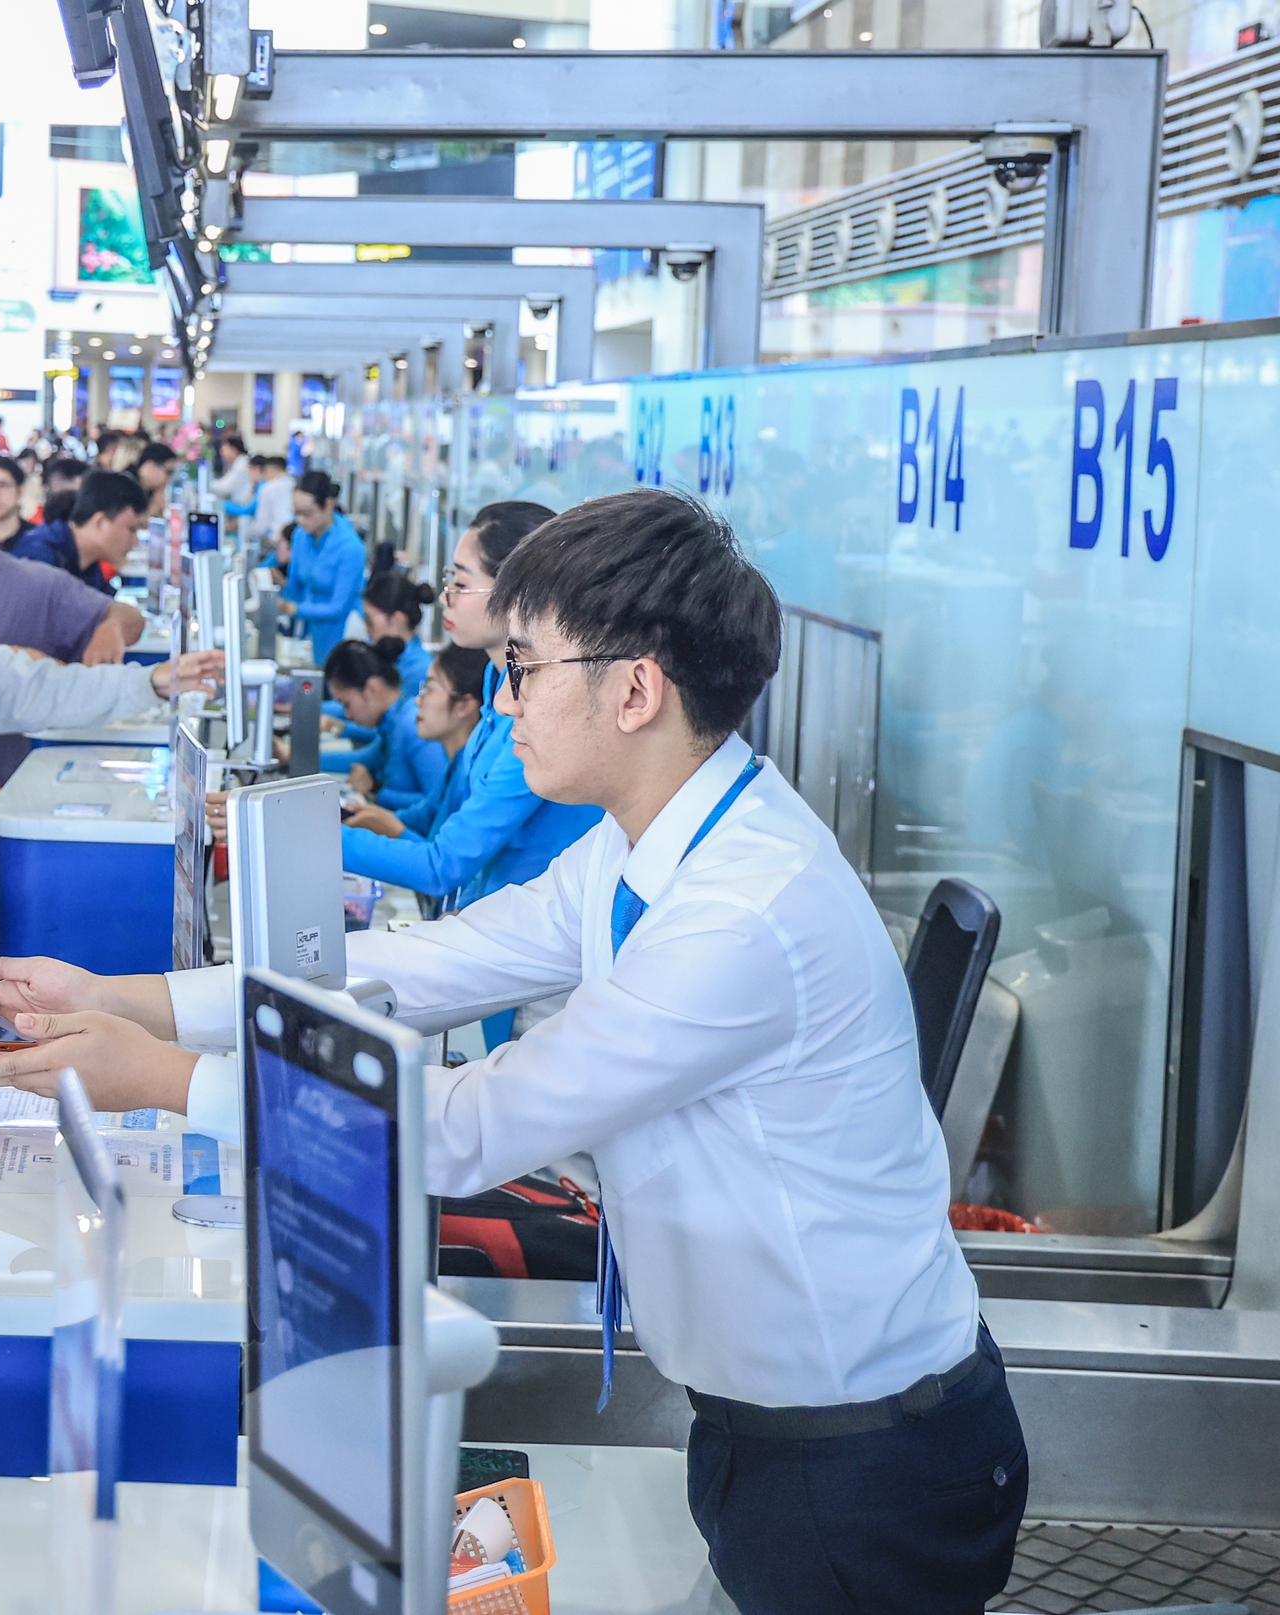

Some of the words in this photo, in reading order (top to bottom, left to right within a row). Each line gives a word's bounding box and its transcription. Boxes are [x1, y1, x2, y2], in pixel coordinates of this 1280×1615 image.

[698, 395, 736, 496] B13
[898, 384, 964, 532] B14
[1070, 377, 1178, 562] B15
